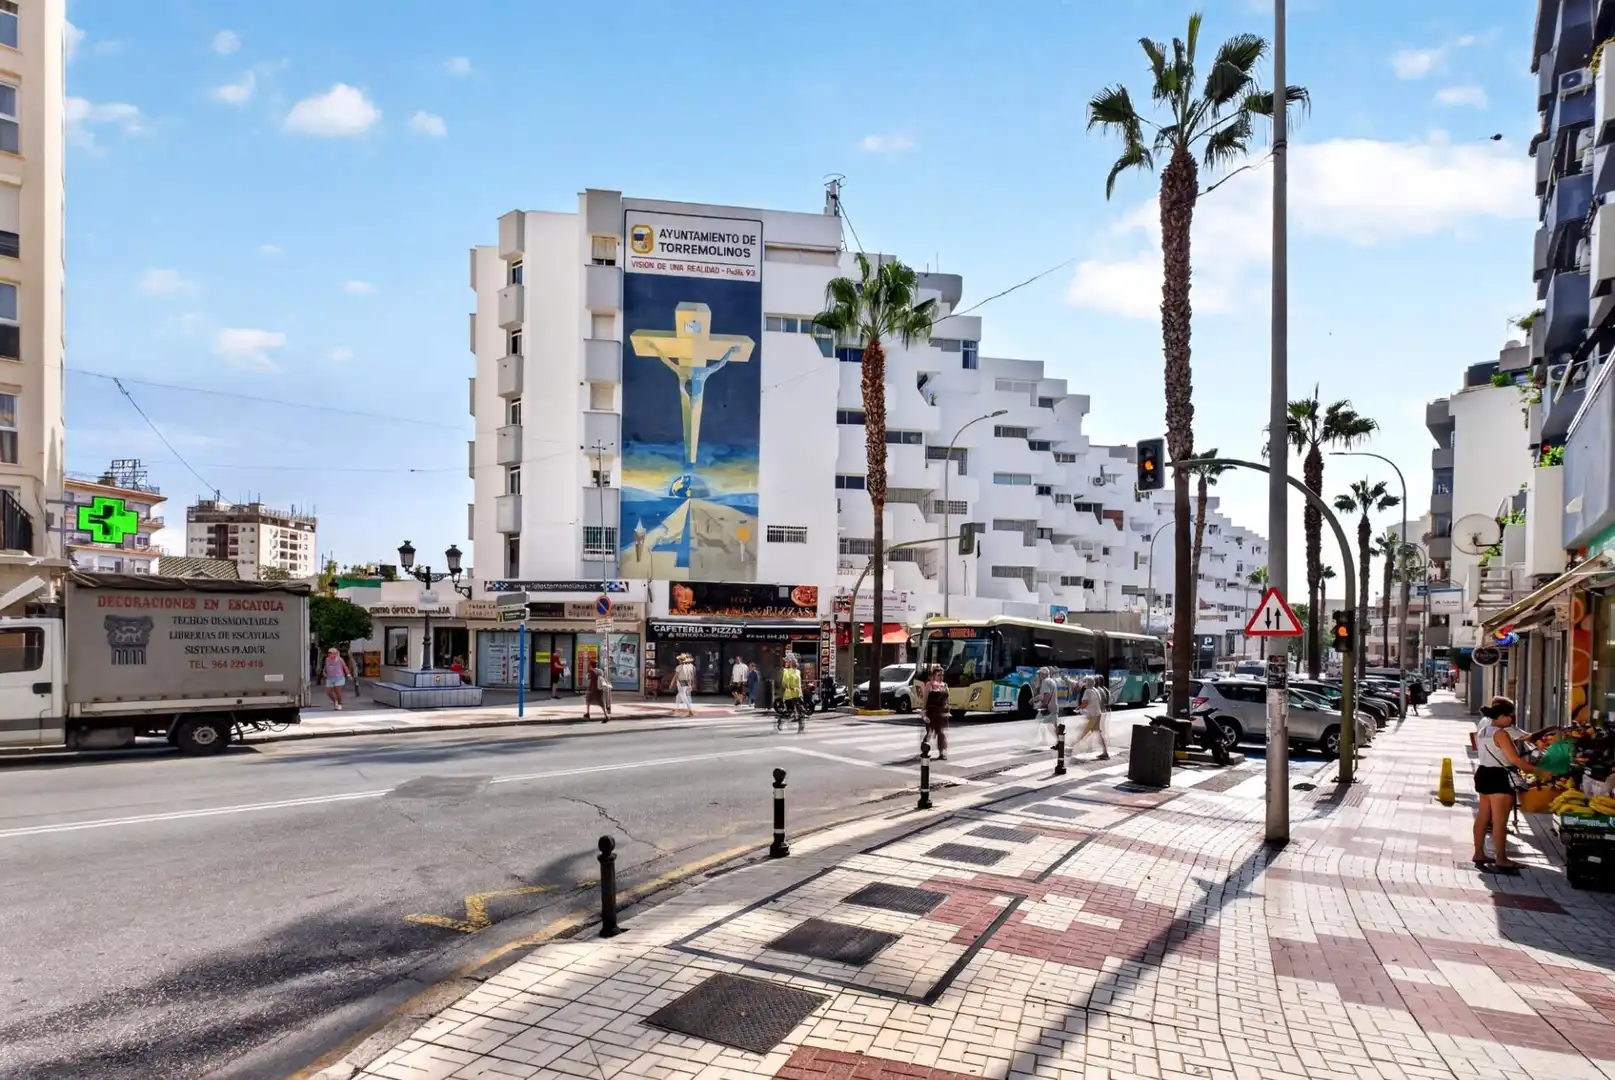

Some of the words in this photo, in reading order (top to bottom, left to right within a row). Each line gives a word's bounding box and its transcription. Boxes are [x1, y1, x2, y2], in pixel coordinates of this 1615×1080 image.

[659, 228, 739, 244] AYUNTAMIENTO
[742, 234, 757, 246] DE
[659, 242, 751, 258] TORREMOLINOS
[631, 260, 654, 269] VISION
[657, 262, 666, 270] DE
[670, 264, 684, 272] UNA
[686, 265, 719, 275] REALIDAD
[745, 269, 756, 277] 93
[97, 595, 197, 609] DECORACIONES
[204, 599, 219, 610] EN
[228, 599, 284, 612] ESCAYOLA
[369, 606, 390, 614] CENTRO
[766, 606, 811, 616] PIZZAS
[172, 616, 209, 625] TECHOS
[211, 616, 279, 626] DESMONTABLES
[169, 630, 216, 640] LIBRERIAS
[218, 631, 230, 639] DE
[232, 631, 280, 639] ESCAYOLAS
[653, 625, 704, 634] CAFETERIA
[712, 627, 743, 635] PIZZAS
[184, 645, 230, 654] SISTEMAS
[232, 645, 266, 654] PLADUR
